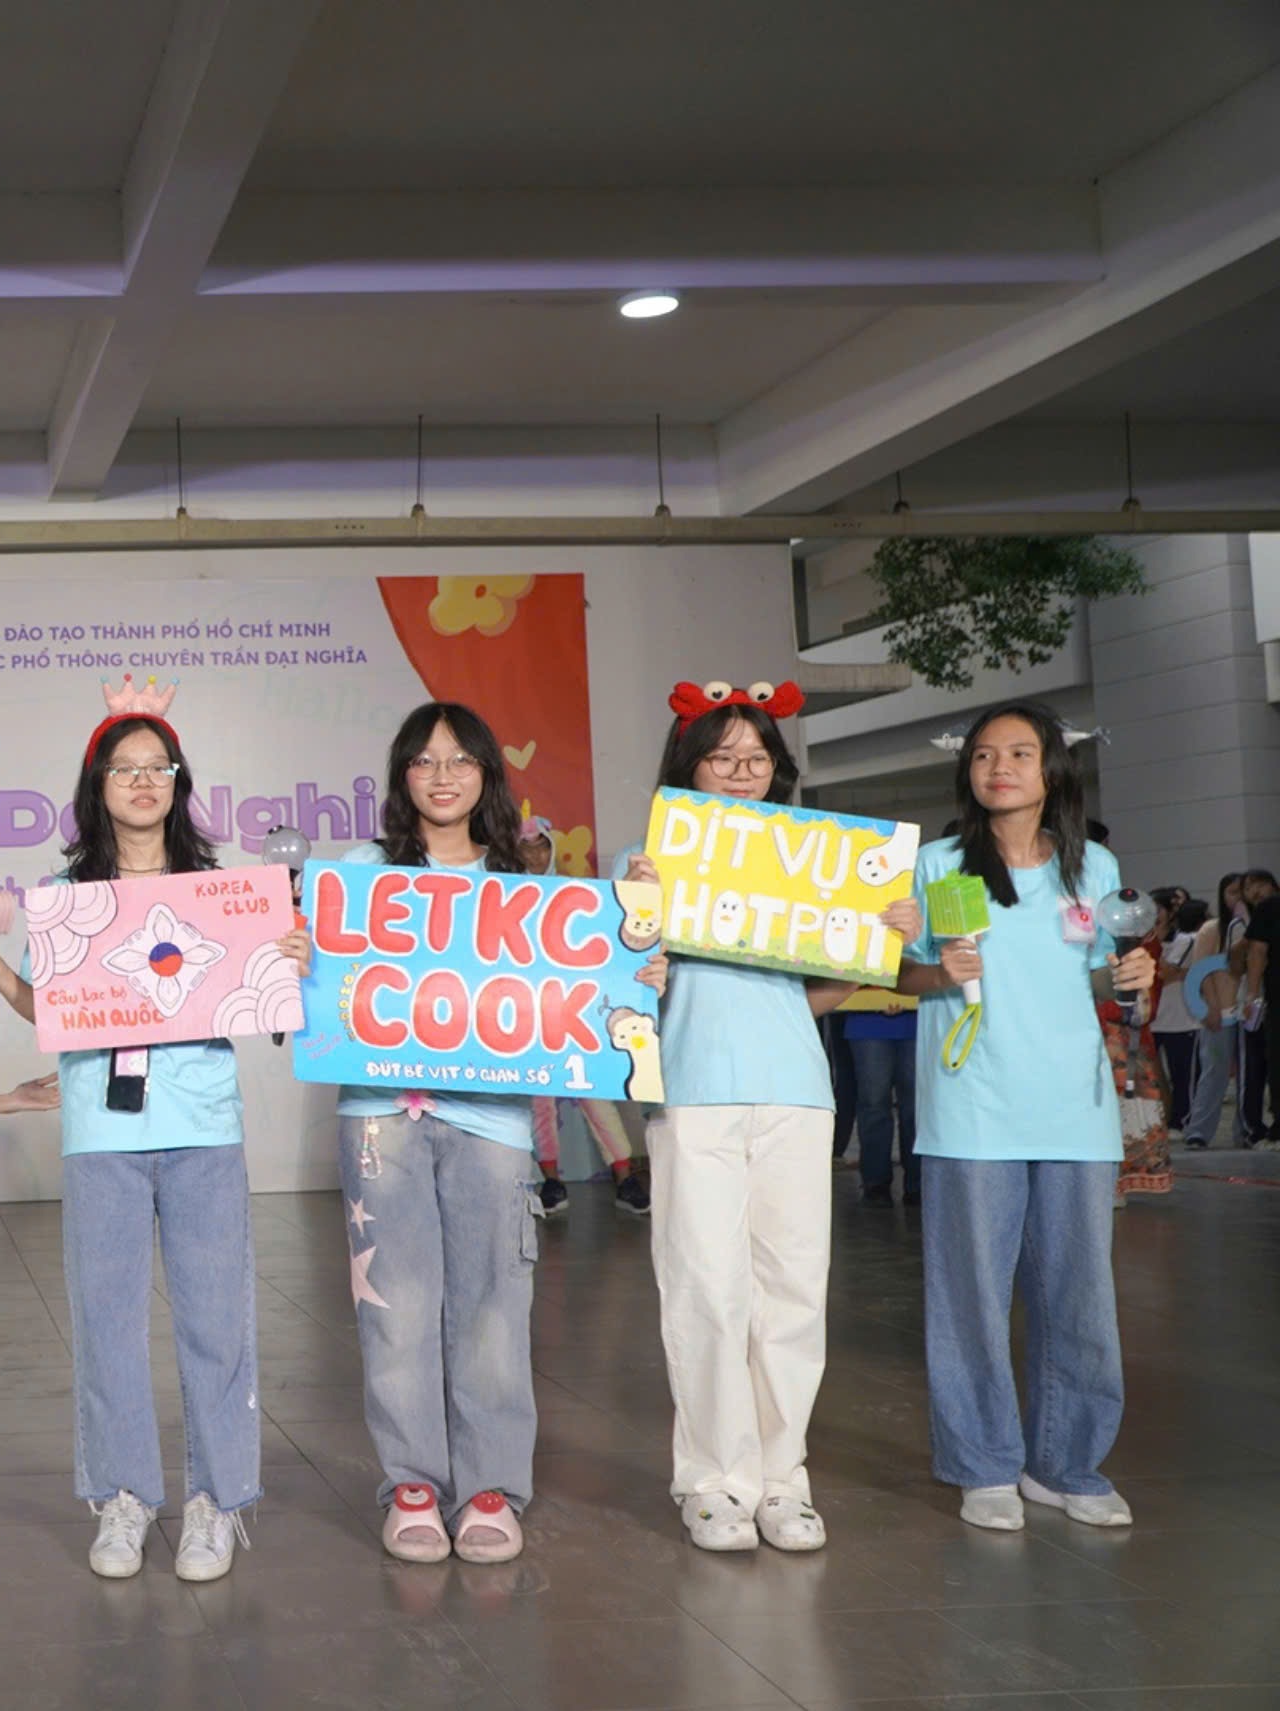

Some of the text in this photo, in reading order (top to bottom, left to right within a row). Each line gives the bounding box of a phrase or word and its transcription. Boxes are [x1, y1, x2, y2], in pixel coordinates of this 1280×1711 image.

[4, 623, 43, 642] ĐÀO
[49, 625, 85, 645] TẠO
[91, 621, 155, 640] THÀNH
[161, 618, 200, 639] PHỐ
[206, 617, 232, 638] HỒ
[238, 619, 273, 638] CHÍ
[279, 622, 331, 638] MINH
[55, 649, 123, 669] THÔNG
[129, 648, 205, 667] CHUYÊN
[265, 650, 299, 669] ĐẠI
[305, 644, 368, 665] NGHĨA
[188, 775, 387, 855] Nghi
[772, 823, 852, 901] VỤ
[195, 880, 254, 898] KOREA
[223, 896, 270, 916] CLUB
[669, 879, 888, 970] HOTPOT
[62, 1006, 107, 1030] HÀN
[351, 963, 602, 1056] COOK
[564, 1053, 595, 1090] 1
